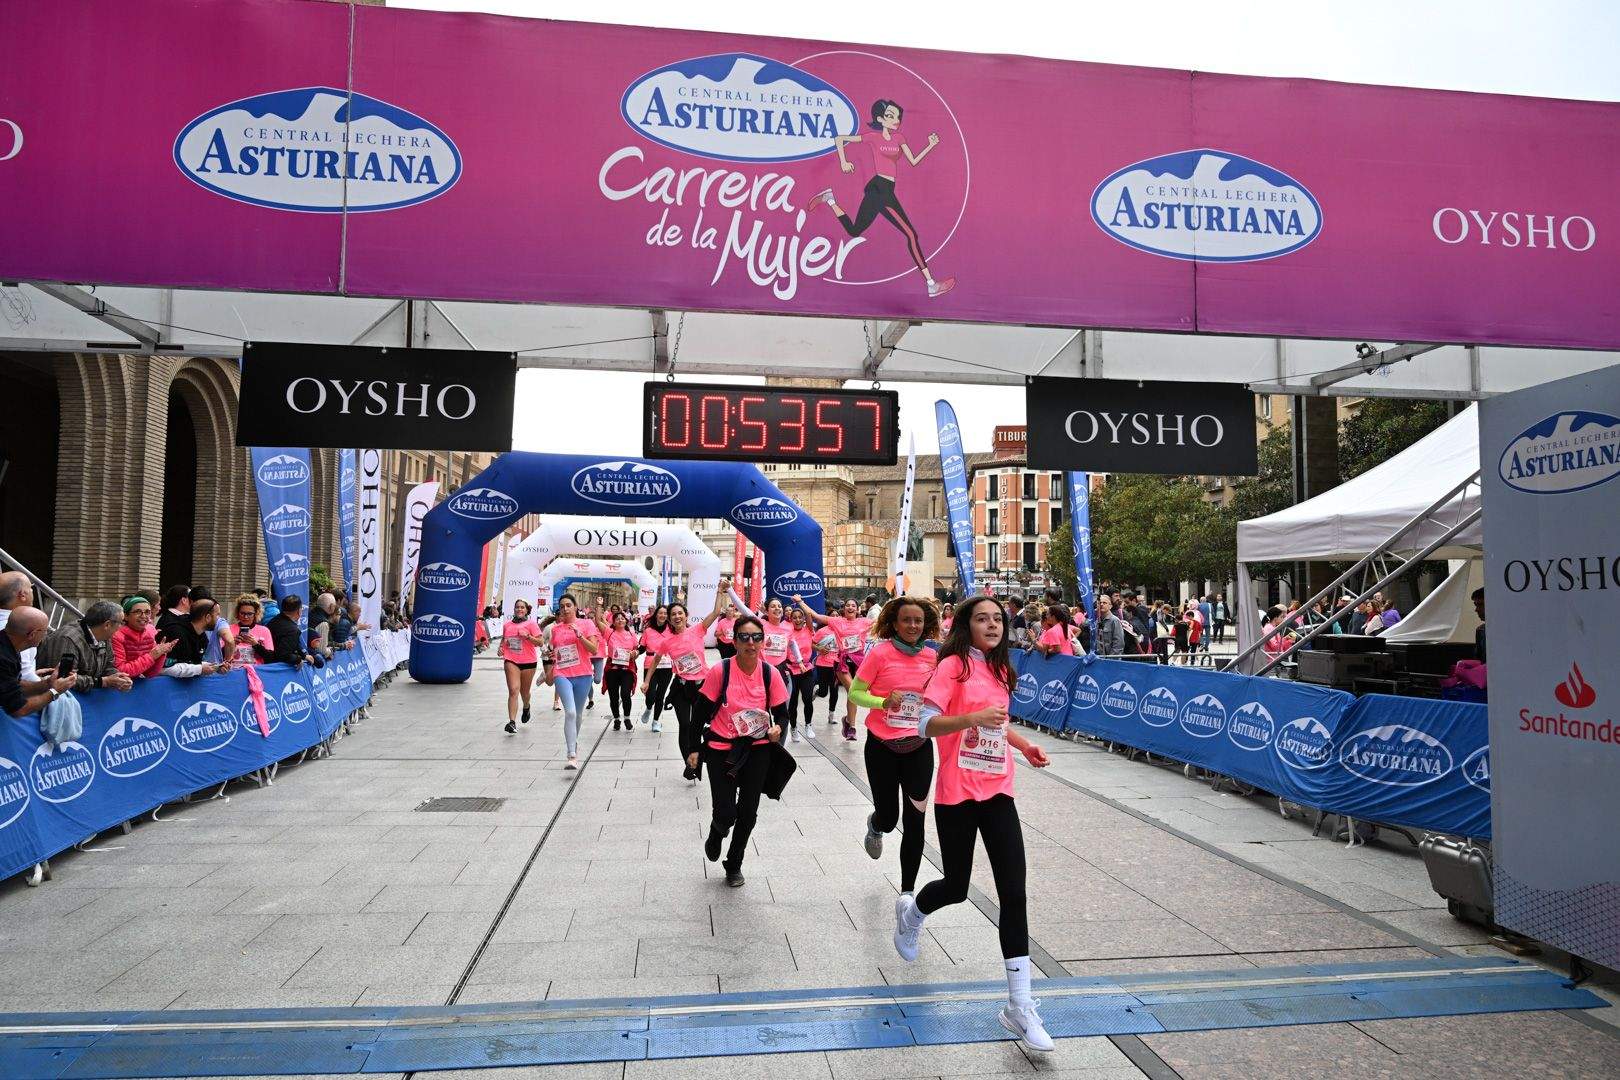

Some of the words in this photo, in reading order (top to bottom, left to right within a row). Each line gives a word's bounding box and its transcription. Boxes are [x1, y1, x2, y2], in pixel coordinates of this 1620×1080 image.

[678, 86, 752, 102] CENTRAL
[760, 93, 834, 108] LECHERA
[639, 86, 839, 139] ASTURIANA
[244, 127, 332, 143] CENTRAL
[342, 131, 431, 148] LECHERA
[196, 127, 440, 185] ASTURIANA
[599, 146, 796, 214] Carrera
[1146, 184, 1218, 200] CENTRAL
[1225, 188, 1298, 203] LECHERA
[1109, 186, 1305, 236] ASTURIANA
[1432, 207, 1596, 252] OYSHO
[646, 208, 683, 246] de
[691, 208, 717, 250] la
[710, 209, 867, 300] Mujer
[286, 377, 476, 420] OYSHO
[997, 431, 1027, 442] TIBUR
[1064, 410, 1224, 447] OYSHO
[1526, 440, 1570, 454] CENTRAL
[580, 473, 673, 496] ASTURIANA
[452, 498, 513, 513] ASTURIANA
[737, 508, 793, 520] ASTURIANA
[573, 528, 658, 547] OYSHO
[420, 571, 467, 586] ASTURIANA
[414, 623, 461, 637] ASTURIANA
[1103, 692, 1135, 711] ASTURIANA
[1140, 698, 1175, 720] ASTURIANA
[1182, 707, 1222, 730] ASTURIANA
[1519, 707, 1620, 744] Santande
[180, 719, 235, 745] ASTURIANA
[980, 738, 999, 749] 016
[105, 738, 167, 769] ASTURIANA
[1345, 742, 1442, 775] ASTURIANA
[36, 761, 92, 792] ASTURIANA
